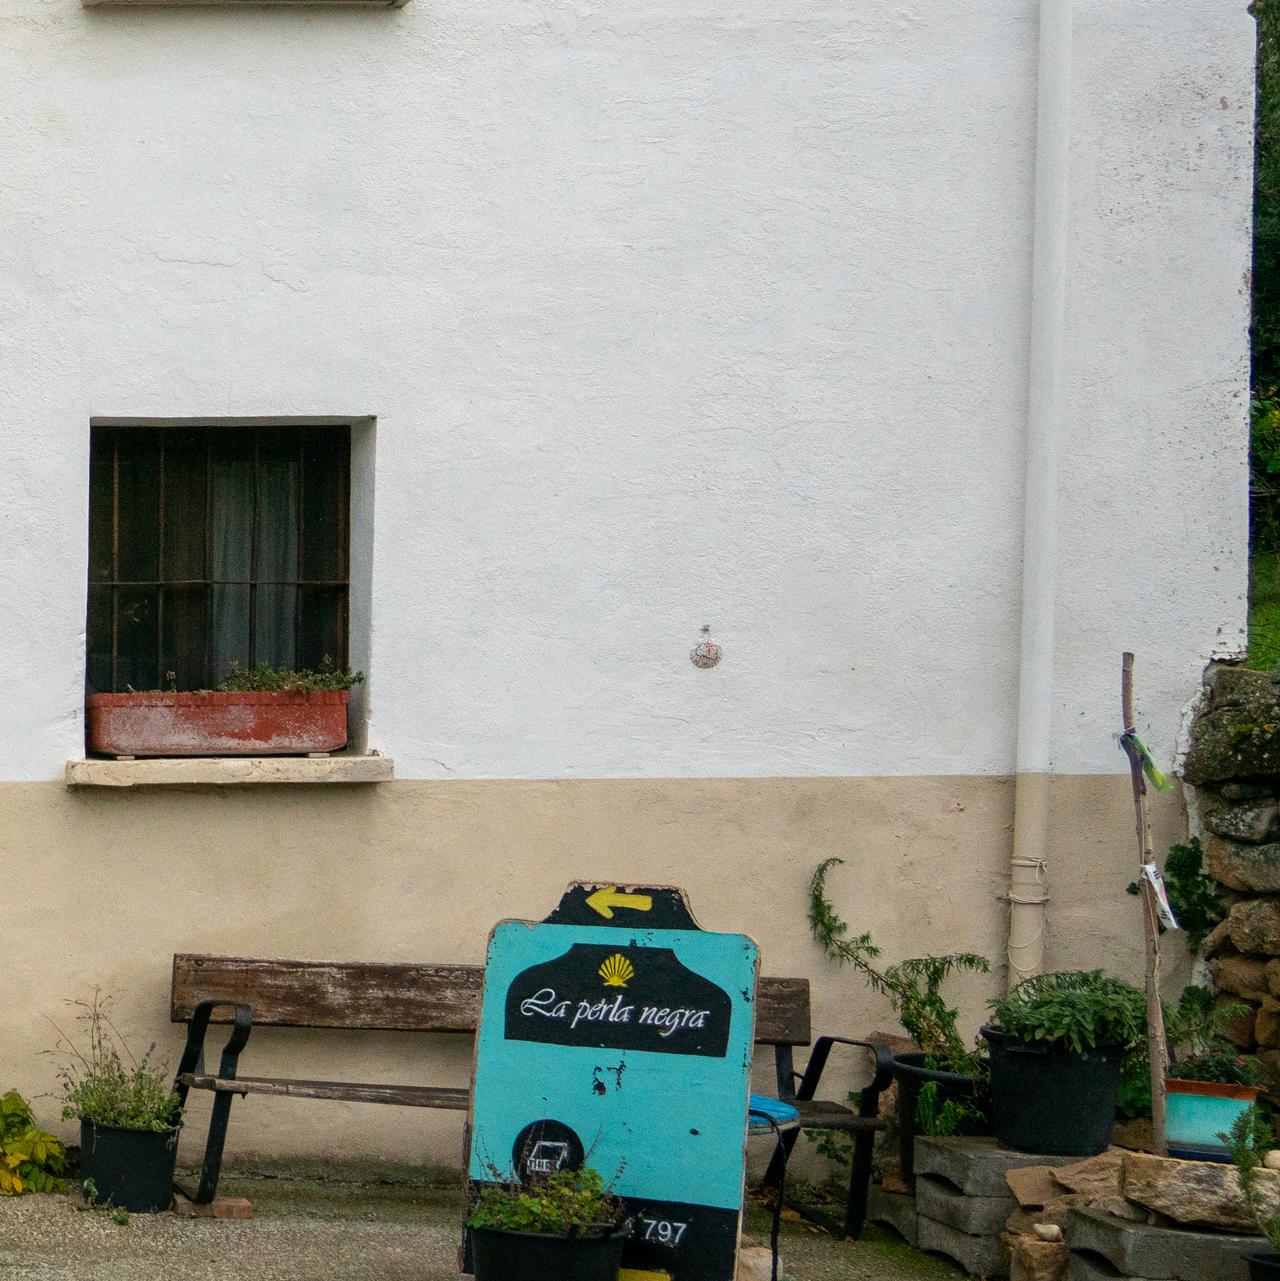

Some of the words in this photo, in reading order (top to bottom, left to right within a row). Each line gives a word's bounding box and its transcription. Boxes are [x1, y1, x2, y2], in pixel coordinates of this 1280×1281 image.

[520, 988, 571, 1018] La
[570, 994, 635, 1029] perla
[638, 1006, 711, 1037] negra
